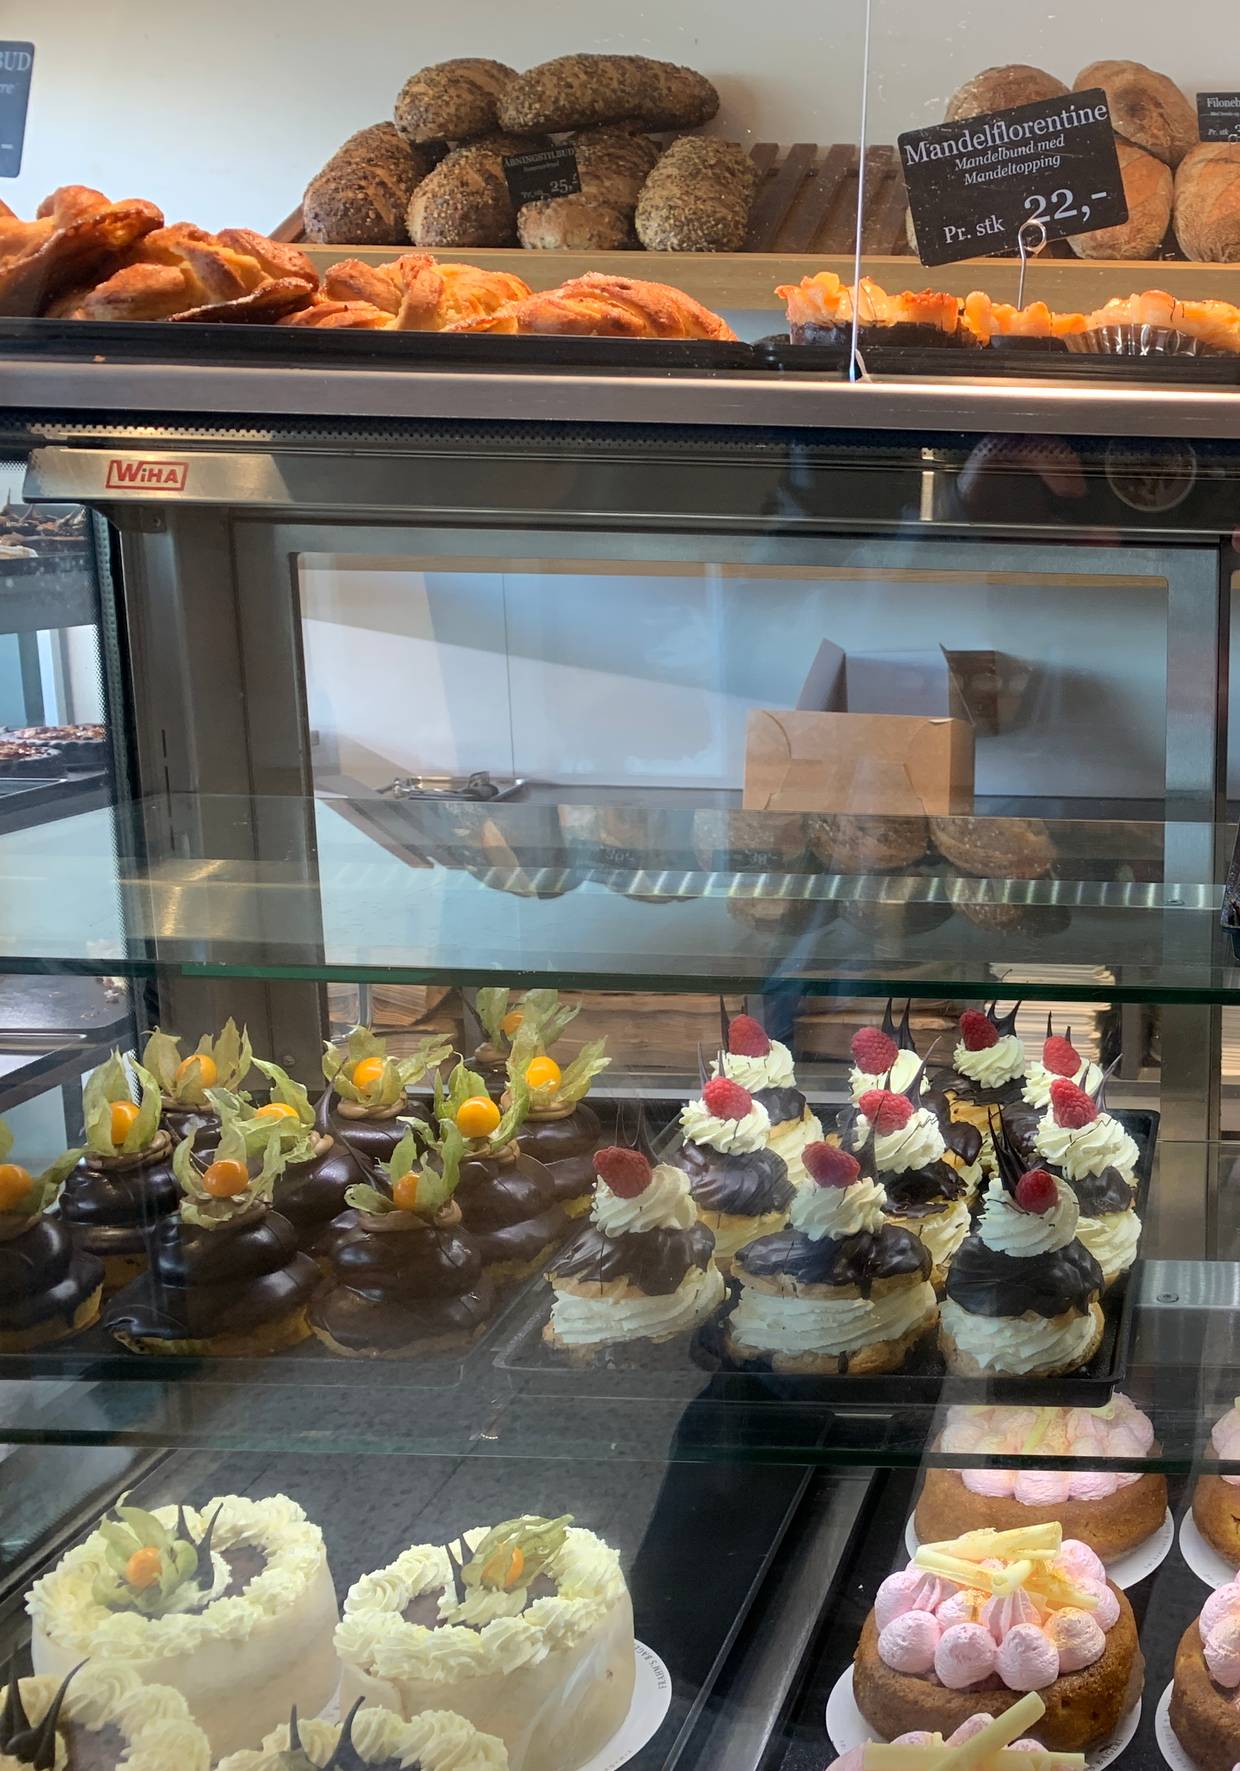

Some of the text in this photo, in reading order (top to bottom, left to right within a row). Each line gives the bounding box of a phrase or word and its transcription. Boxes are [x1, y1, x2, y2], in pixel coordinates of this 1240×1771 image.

[904, 104, 1108, 166] Mandelflorentine
[954, 134, 1065, 171] Mandelbund med
[963, 155, 1062, 186] Mandeltopping
[943, 188, 1107, 244] Pr. stk 22,-
